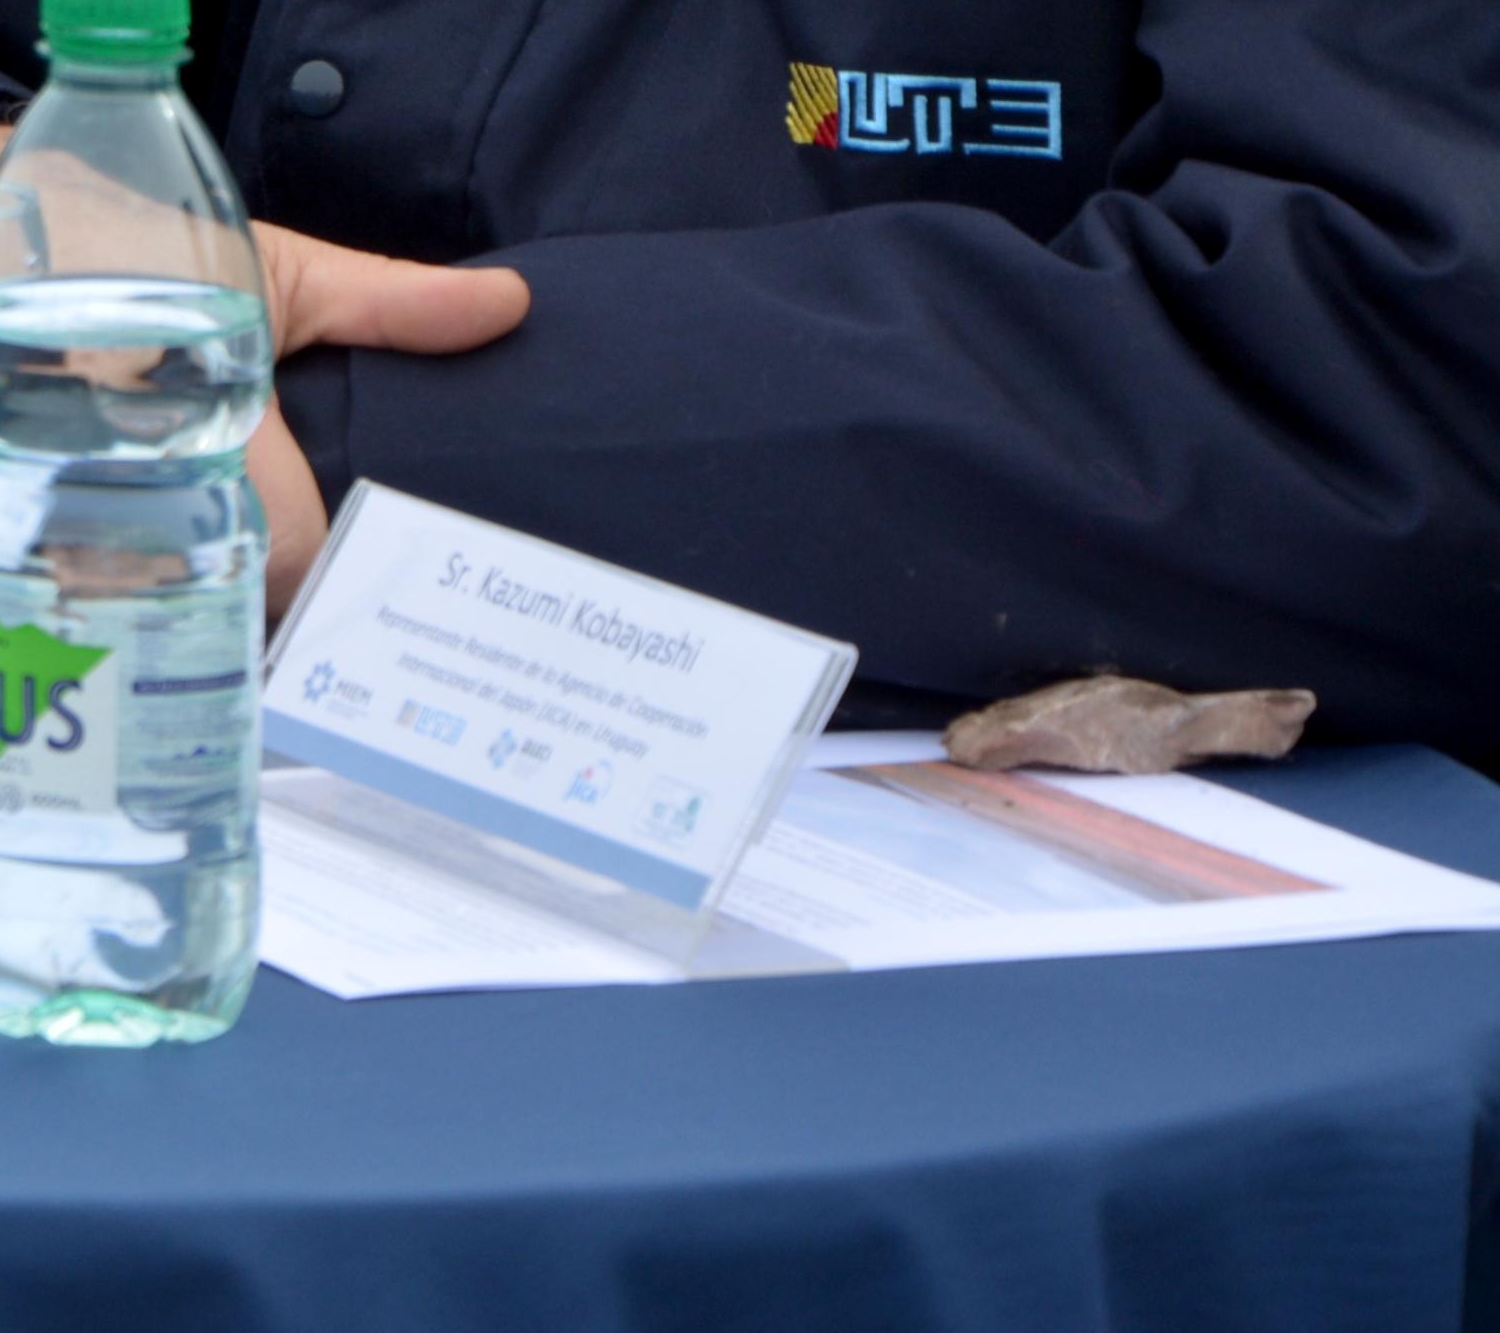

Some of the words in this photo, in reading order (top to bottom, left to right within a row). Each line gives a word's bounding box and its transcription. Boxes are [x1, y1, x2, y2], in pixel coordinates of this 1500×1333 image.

[438, 551, 472, 595] Sr.
[477, 566, 574, 629] Kazumi
[569, 598, 706, 675] Kobayashi
